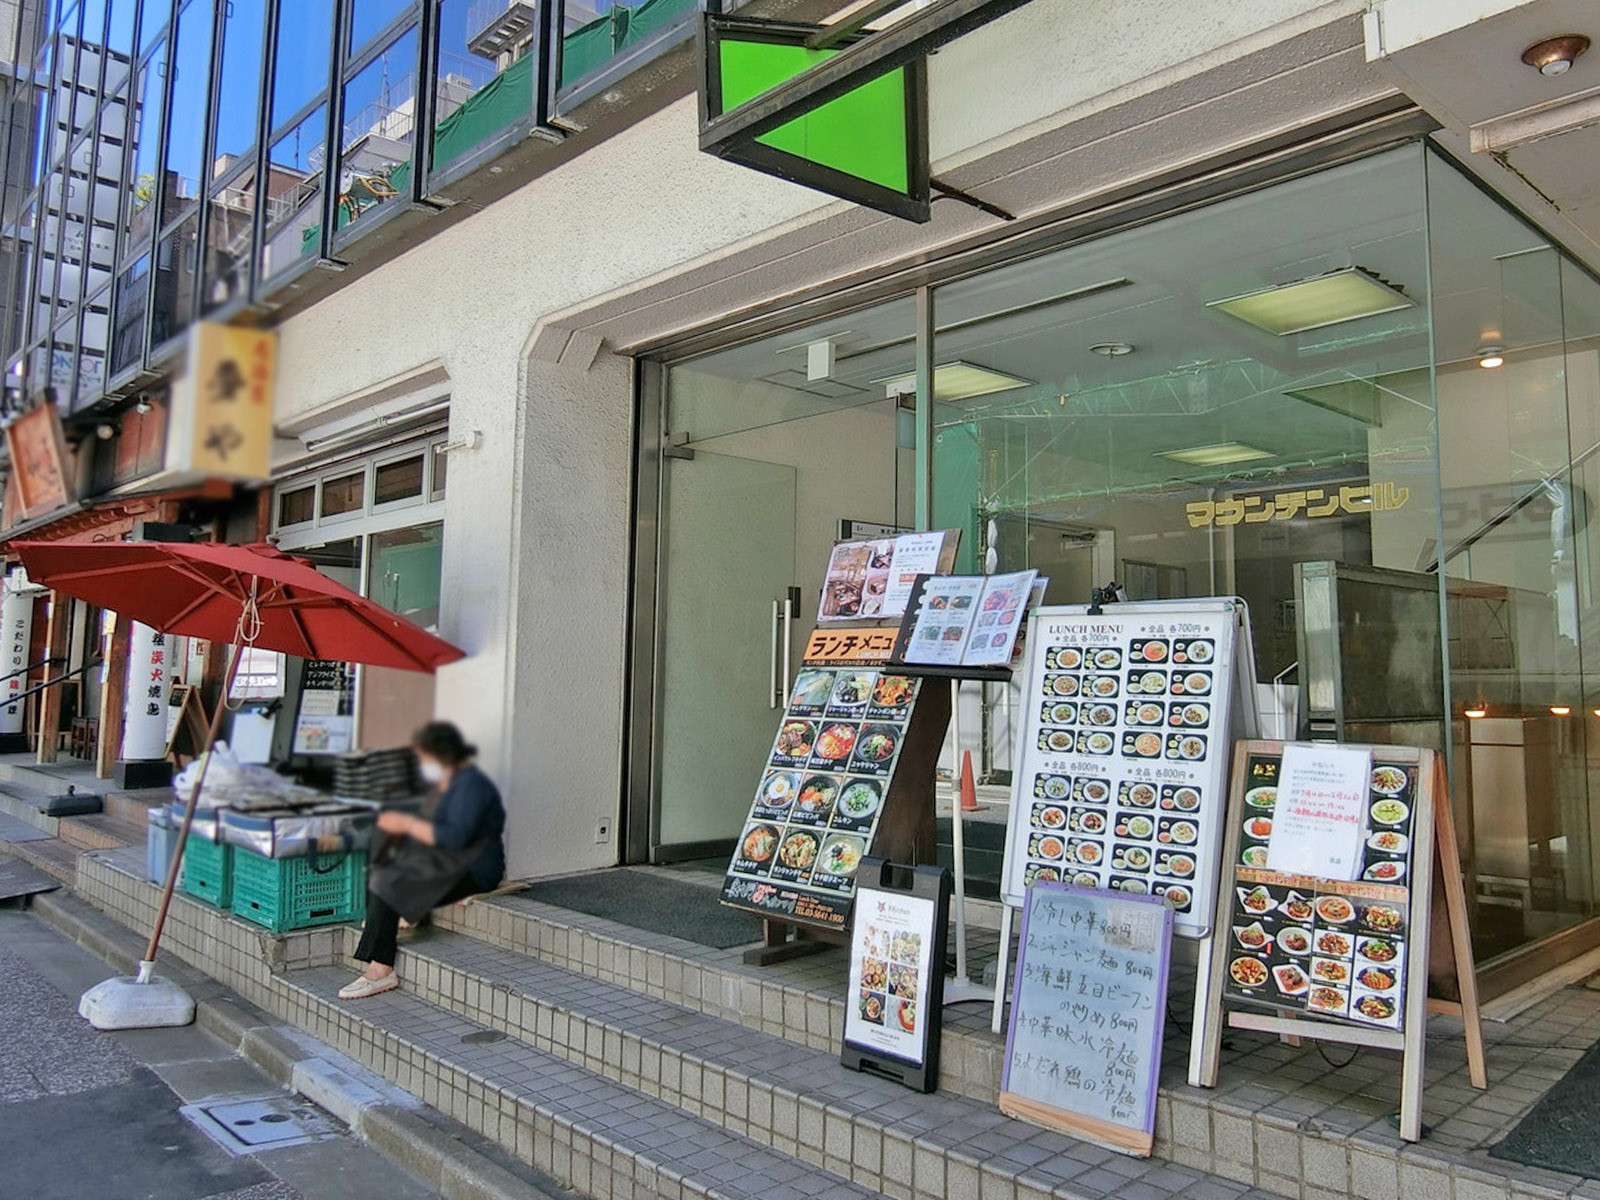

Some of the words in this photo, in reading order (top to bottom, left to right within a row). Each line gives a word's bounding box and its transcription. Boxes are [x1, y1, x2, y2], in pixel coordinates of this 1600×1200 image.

[1186, 481, 1409, 528] マウンテンビル
[1049, 624, 1088, 634] LUNCH
[1090, 624, 1124, 634] MENU
[811, 635, 897, 657] ランチメニュ
